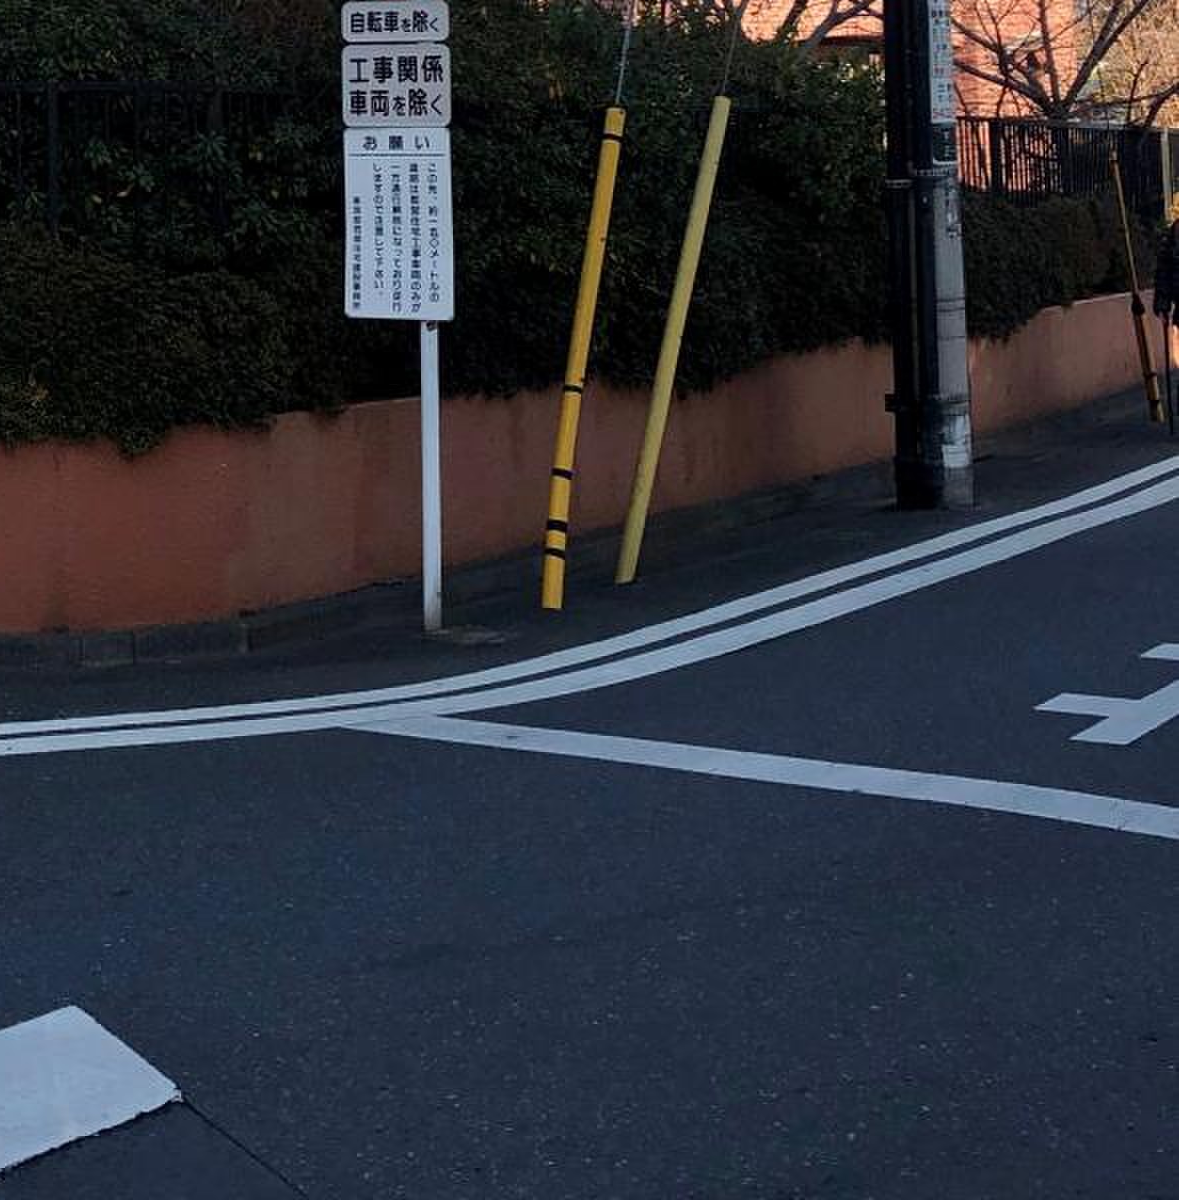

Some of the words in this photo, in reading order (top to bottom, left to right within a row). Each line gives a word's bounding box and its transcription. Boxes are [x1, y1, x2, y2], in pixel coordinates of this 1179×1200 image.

[350, 10, 438, 33] 自転車を除く
[349, 55, 444, 84] 工事関係
[349, 89, 443, 117] 車両を除く
[362, 135, 431, 150] お願い
